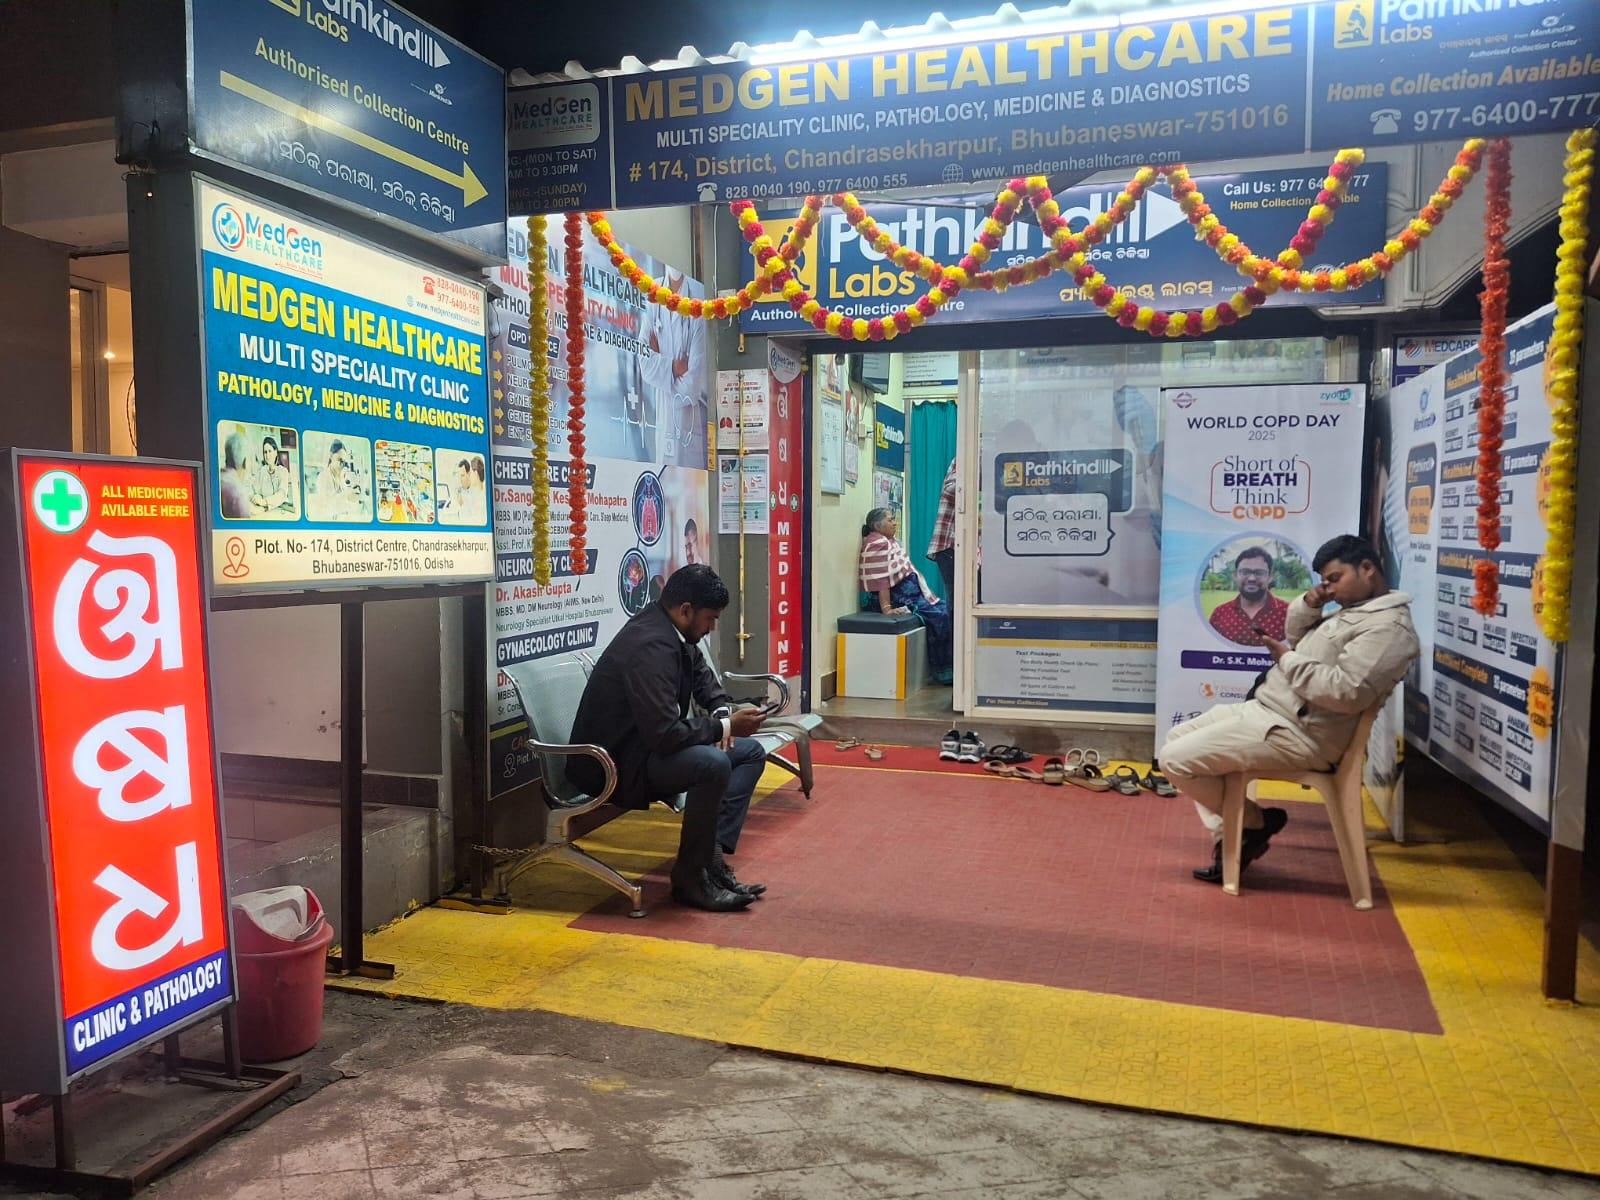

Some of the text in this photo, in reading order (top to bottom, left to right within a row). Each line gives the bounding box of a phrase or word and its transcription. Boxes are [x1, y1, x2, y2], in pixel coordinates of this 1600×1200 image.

[306, 1, 349, 43] Labs
[1380, 22, 1432, 45] Labs
[625, 8, 1293, 122] MEDGEN HEALTHCARE
[1327, 52, 1600, 101] Home Collection Available
[255, 37, 469, 155] Authorised Collection Centre
[514, 96, 591, 118] MedGen
[656, 74, 1251, 148] MULTI SPECIALITY CLINIC, PATHOLOGY, MEDICINE & DIAGNOSTICS
[514, 112, 592, 131] HEALTHCARE
[629, 103, 1290, 182] # 174, District, Chandrasekharpur, Bhubaneswar-751016
[556, 148, 597, 161] TO SAT)
[1012, 149, 1181, 175] medgenhealthcare.com
[726, 173, 907, 199] 828 0040 977 6400 555
[1223, 179, 1303, 196] Call Us: 977
[1230, 199, 1258, 211] Home
[1262, 196, 1312, 208] Collection
[245, 211, 323, 258] MedGen
[246, 236, 323, 271] HEALTHCARE
[830, 264, 915, 299] Labs
[213, 267, 483, 376] MEDGEN HEALTHCARE
[510, 330, 527, 344] OPD
[596, 327, 650, 358] & DIAGNOSTICS
[239, 332, 470, 405] MULTI SPECIALITY CLINIC
[218, 371, 485, 435] PATHOLOGY, MEDICINE & DIAGNOSTICS
[1187, 414, 1341, 429] WORLD COPD DAY
[1248, 430, 1276, 441] 2025
[495, 461, 529, 481] CHEST
[1025, 458, 1100, 476] Pathkind
[1223, 454, 1299, 472] Short of
[1025, 477, 1051, 487] Labs
[1223, 473, 1298, 487] BREATH
[102, 485, 188, 500] ALL MEDICINES
[587, 493, 627, 508] Mohapatra
[1231, 487, 1288, 505] Think
[102, 504, 190, 518] AVILABLE HERE
[1232, 505, 1287, 520] COPD
[495, 527, 516, 536] Trained
[255, 539, 283, 554] Plot.
[311, 539, 333, 555] 174,
[336, 538, 374, 553] District
[376, 538, 409, 554] Centre,
[412, 537, 489, 554] Chandrasekharpur,
[312, 557, 454, 575] Bhubaneswar-751016, Odisha
[495, 587, 510, 602] Dr.
[545, 582, 572, 598] Gupta
[777, 521, 790, 675] MEDICINE
[527, 604, 537, 613] DM
[537, 601, 563, 612] Neurology
[496, 621, 525, 633] Neurology
[497, 628, 594, 662] GYNAECOLOGY CLINIC
[1212, 656, 1245, 665] Dr. S.K.
[72, 957, 223, 1052] CLINIC & PATHOLOGY
